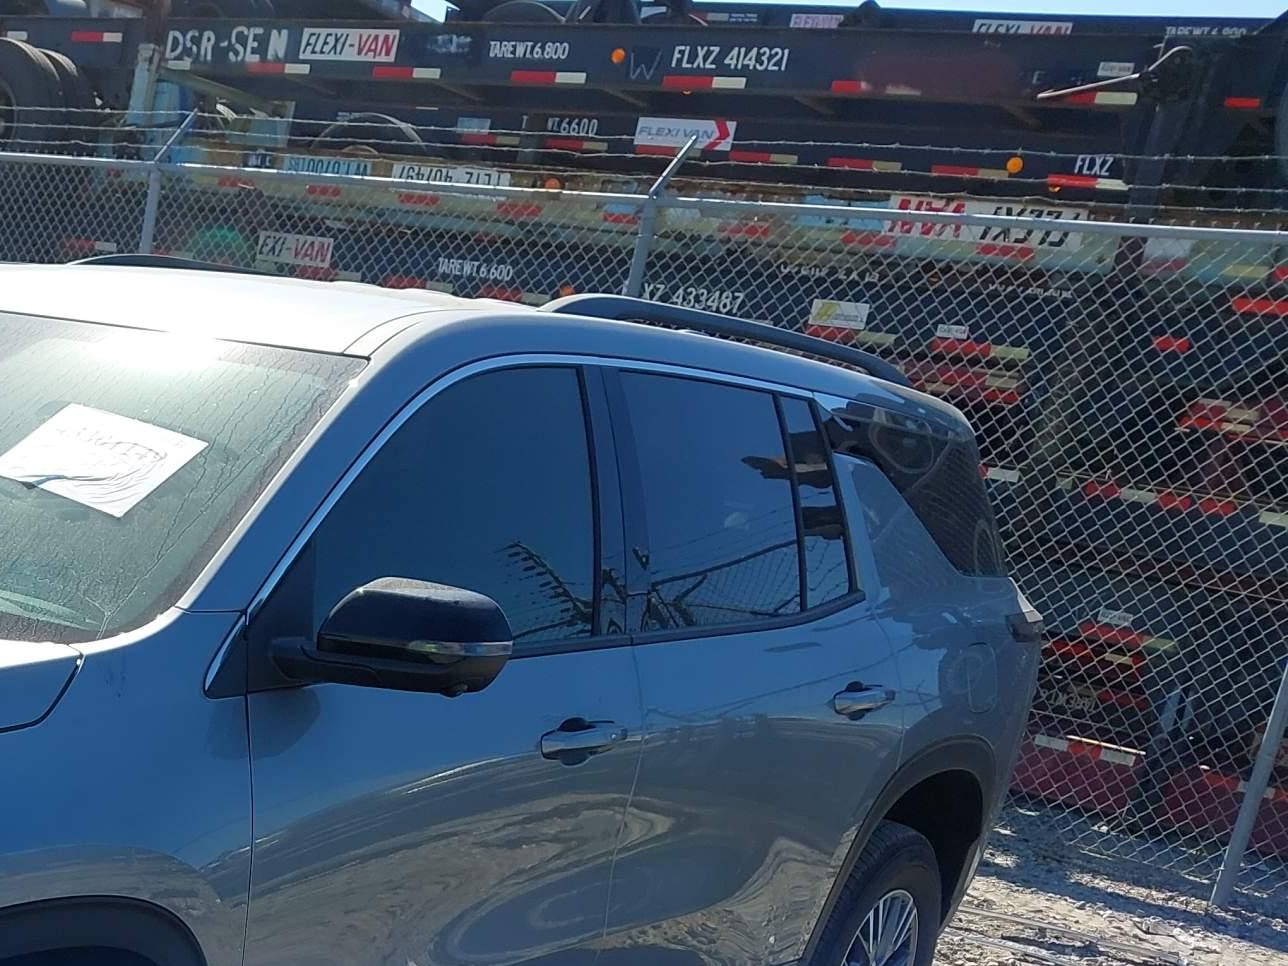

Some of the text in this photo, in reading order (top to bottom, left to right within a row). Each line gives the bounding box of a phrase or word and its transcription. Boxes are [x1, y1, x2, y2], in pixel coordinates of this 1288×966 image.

[302, 32, 397, 58] FLEXI-VAN
[671, 45, 790, 71] FLXZ 414321
[638, 126, 714, 140] FLEXI VAN
[1074, 154, 1114, 176] FLXZ
[672, 286, 744, 315] 433487
